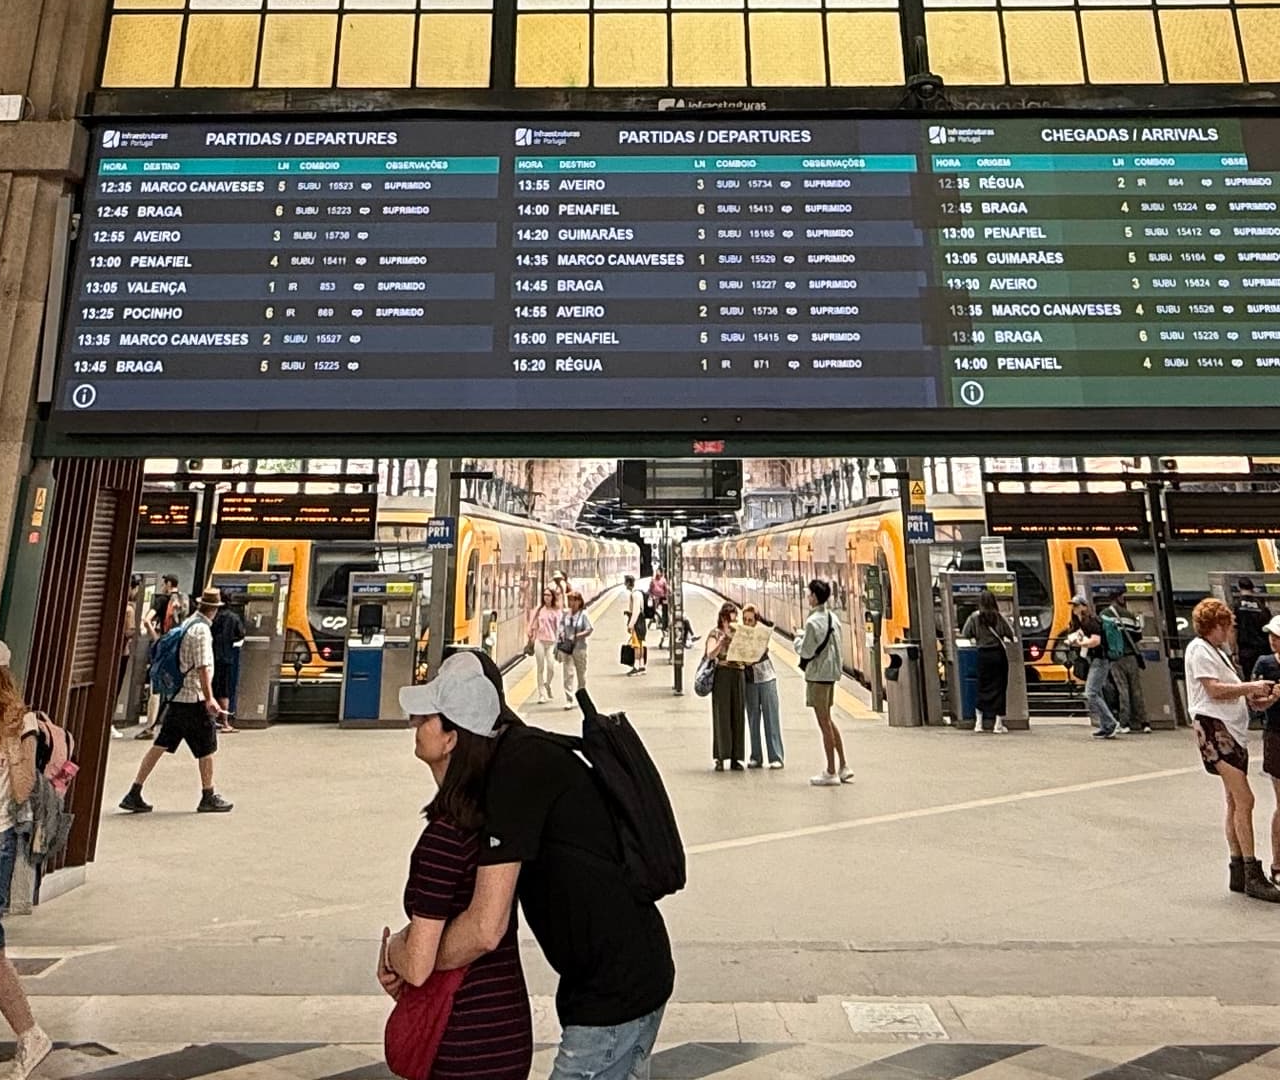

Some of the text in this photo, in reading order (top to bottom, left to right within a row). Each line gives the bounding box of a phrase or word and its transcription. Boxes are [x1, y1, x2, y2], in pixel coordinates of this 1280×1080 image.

[206, 132, 397, 145] PARTIDAS / DEPARTURES
[619, 130, 811, 143] PARTIDAS / DEPARTURES
[1042, 128, 1218, 141] CHEGADAS / ARRIVALS
[386, 160, 448, 170] OBSERVAÇÕES
[695, 160, 705, 168] LN
[802, 158, 865, 168] OBSERVAÇÕES
[936, 159, 961, 167] HORA
[1134, 158, 1175, 166] COMBOIO
[101, 182, 131, 192] 12:35
[141, 182, 187, 192] MARCO
[190, 181, 264, 192] CANAVESES
[278, 181, 285, 191] 5
[519, 180, 549, 190] 13:55
[559, 180, 605, 190] AVEIRO
[697, 179, 704, 189] 3
[940, 178, 970, 189] 12:35
[980, 175, 1024, 188] RÉGUA
[1118, 177, 1125, 188] 2
[98, 206, 429, 217] 12:45 BRAGA 6 SUPRIMIDO
[518, 205, 549, 215] 14:00
[559, 204, 619, 215] PENAFIEL
[698, 204, 704, 214] 6
[942, 203, 972, 213] 12:45
[982, 202, 1027, 213] BRAGA
[1121, 202, 1129, 212] 4
[94, 231, 280, 242] 12:55 AVEIRO 3
[517, 228, 853, 240] 14:20 GUIMARÃES 3 SUPRIMIDO
[943, 228, 974, 238] 13:00
[985, 227, 1046, 238] PENAFIEL
[1125, 227, 1132, 237] 5
[90, 256, 427, 267] 13:00 PENAFIEL 4 SUPRIMIDO
[517, 255, 548, 265] 14:35
[558, 254, 605, 265] MARCO
[608, 254, 684, 265] CANAVESES
[699, 254, 704, 264] 1
[808, 255, 855, 263] SUPRIMIDO
[945, 253, 977, 264] 13:05
[987, 251, 1063, 264] GUIMARÃES
[1129, 252, 1136, 263] 5
[86, 282, 425, 295] 13:05 VALENÇA 1 SUPRIMIDO
[516, 280, 856, 291] 14:45 BRAGA 6 SUPRIMIDO
[947, 279, 979, 290] 13:30
[990, 278, 1037, 289] AVEIRO
[1132, 278, 1139, 289] 3
[82, 308, 424, 319] 13:25 POCINHO 6 SUPRIMIDO
[515, 306, 858, 317] 14:55 AVEIRO 2 SUPRIMIDO
[951, 305, 982, 316] 13:35
[992, 304, 1040, 316] MARCO
[1043, 304, 1121, 316] CANAVESES
[1136, 304, 1144, 315] 4
[79, 334, 110, 345] 13:35
[120, 334, 168, 345] MARCO
[171, 334, 248, 345] CANAVESES
[263, 334, 270, 345] 2
[514, 333, 546, 344] 15:00
[557, 332, 619, 344] PENAFIEL
[701, 332, 707, 343] 5
[812, 333, 860, 341] SUPRIMIDO
[954, 331, 985, 343] 13:40
[995, 331, 1042, 342] BRAGA
[1140, 331, 1147, 341] 6
[75, 361, 268, 372] 13:45 BRAGA 5
[513, 357, 862, 371] 15:20 RÉGUA 1 SUPRIMIDO
[955, 358, 987, 369] 14:00
[998, 358, 1062, 369] PENAFIEL
[1144, 358, 1151, 368] 4
